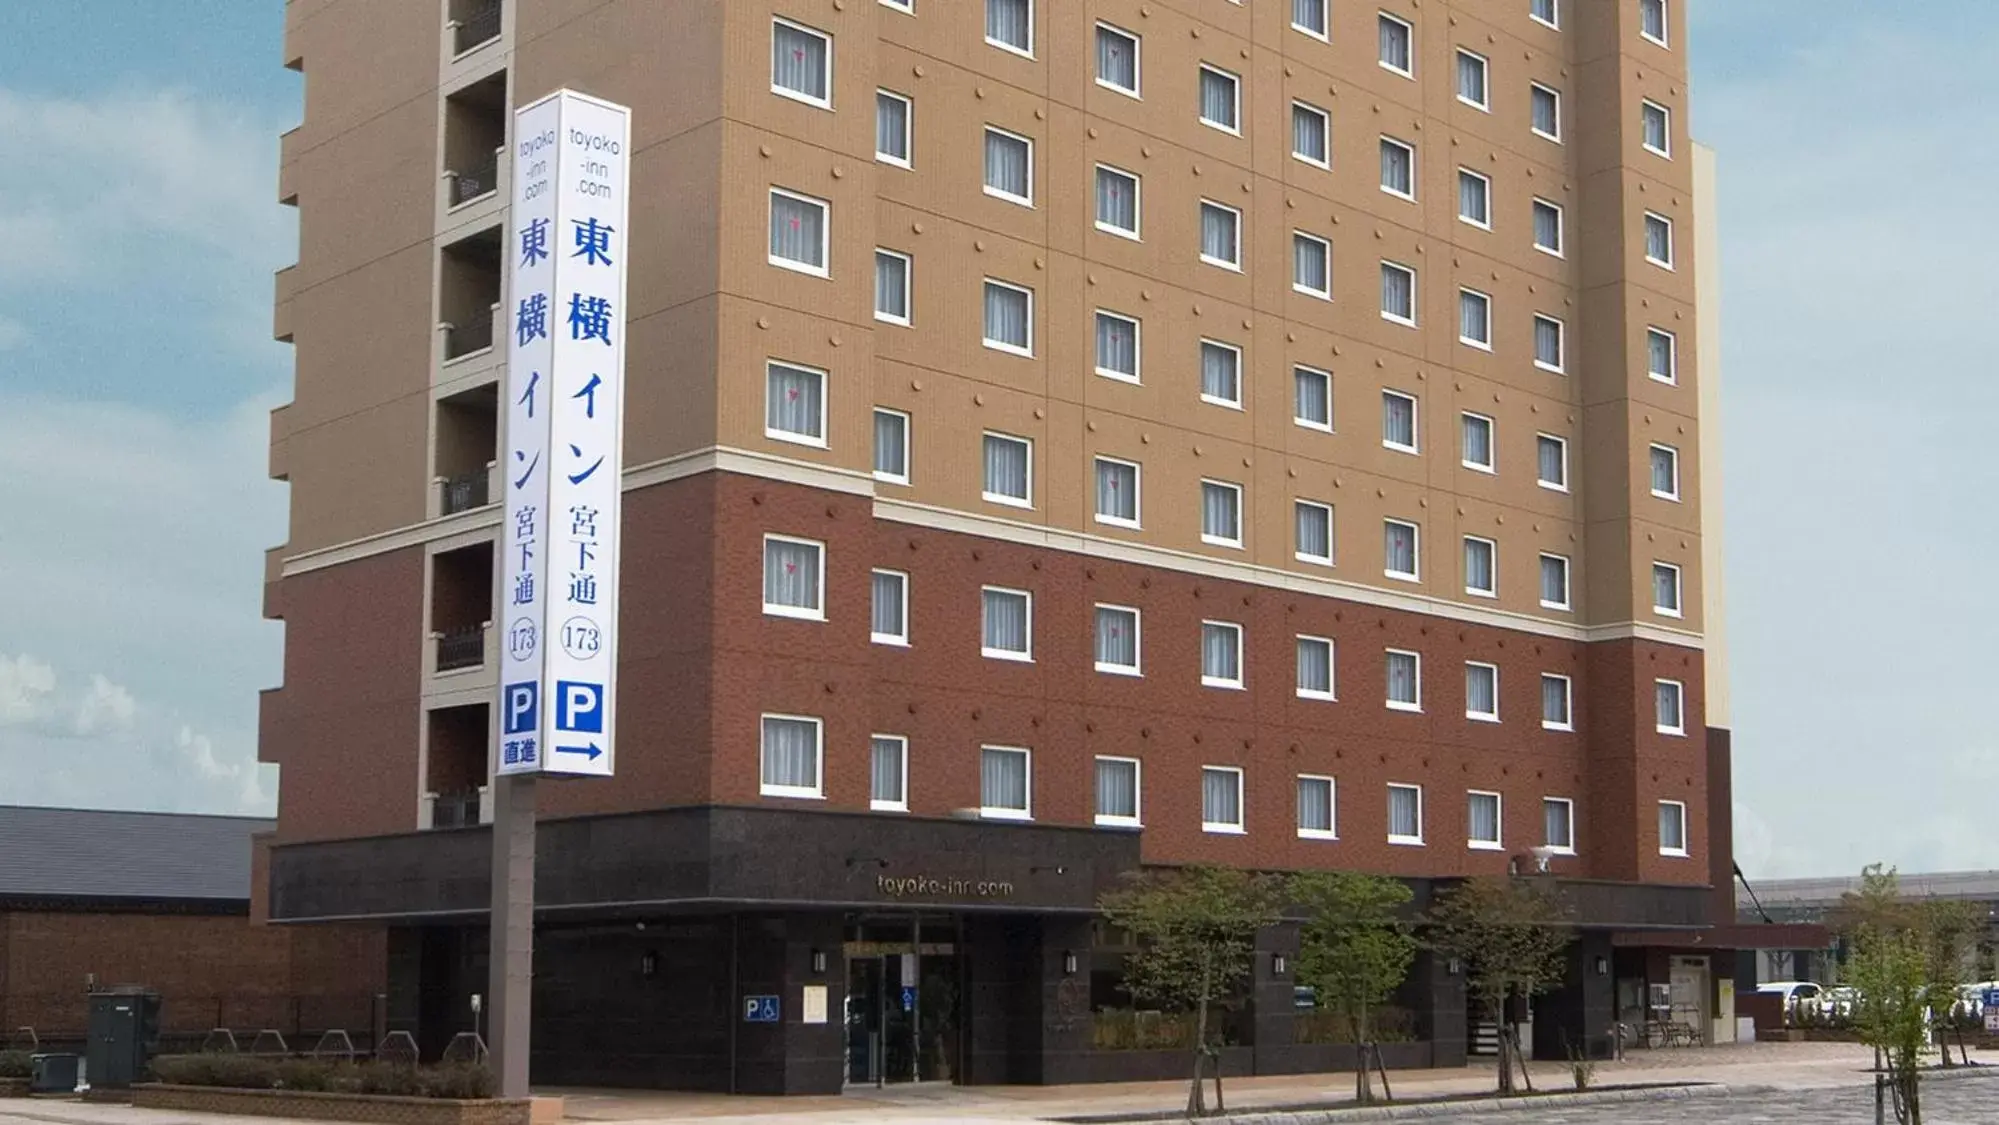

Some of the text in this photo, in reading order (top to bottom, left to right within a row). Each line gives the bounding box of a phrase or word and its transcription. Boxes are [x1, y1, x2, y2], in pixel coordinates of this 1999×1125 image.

[569, 127, 619, 155] toyoko
[580, 160, 608, 178] -inn
[576, 179, 612, 199] .com
[511, 624, 537, 652] 173
[565, 625, 599, 652] 173
[511, 687, 532, 730] P
[566, 685, 596, 728] P
[504, 738, 536, 764] 直進
[747, 999, 759, 1017] P
